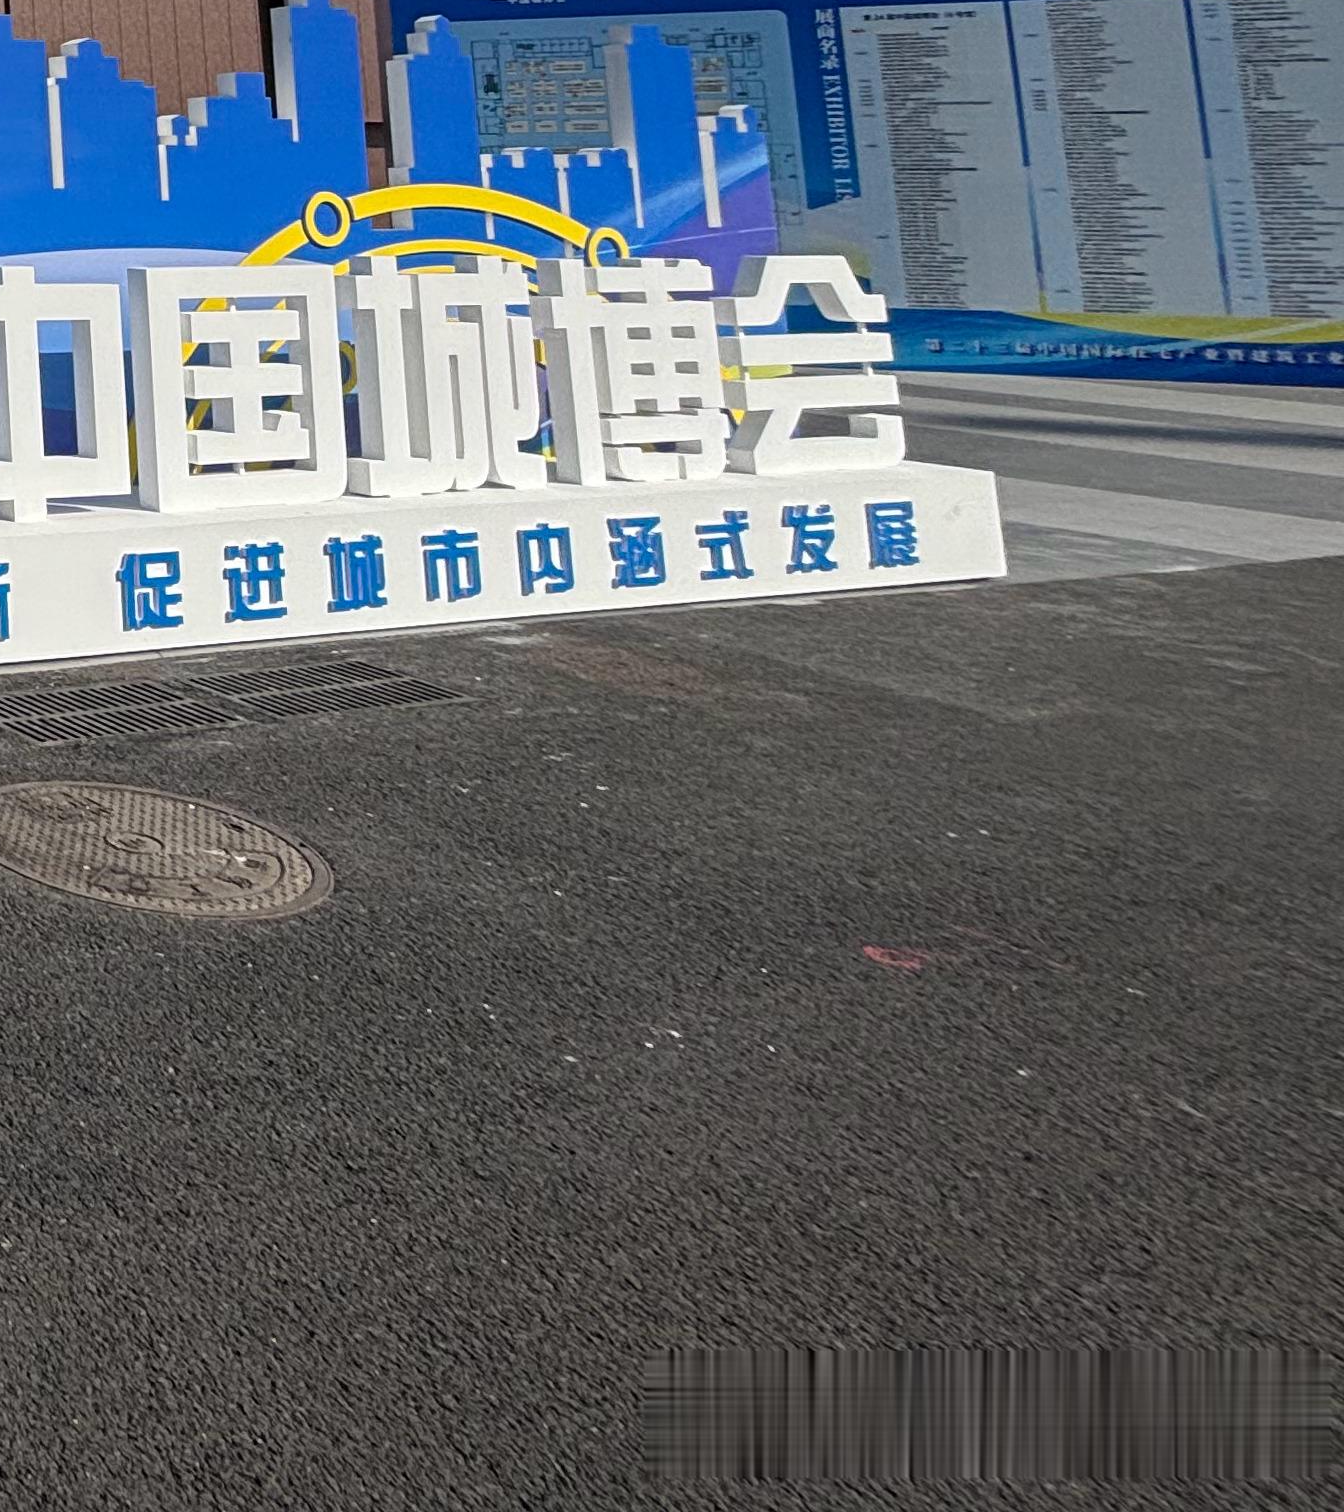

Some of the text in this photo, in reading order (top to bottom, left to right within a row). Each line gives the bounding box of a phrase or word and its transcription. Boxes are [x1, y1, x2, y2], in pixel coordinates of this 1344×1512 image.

[822, 74, 851, 171] EXHIBITOR
[116, 500, 922, 632] 促进城市内涵式发展
